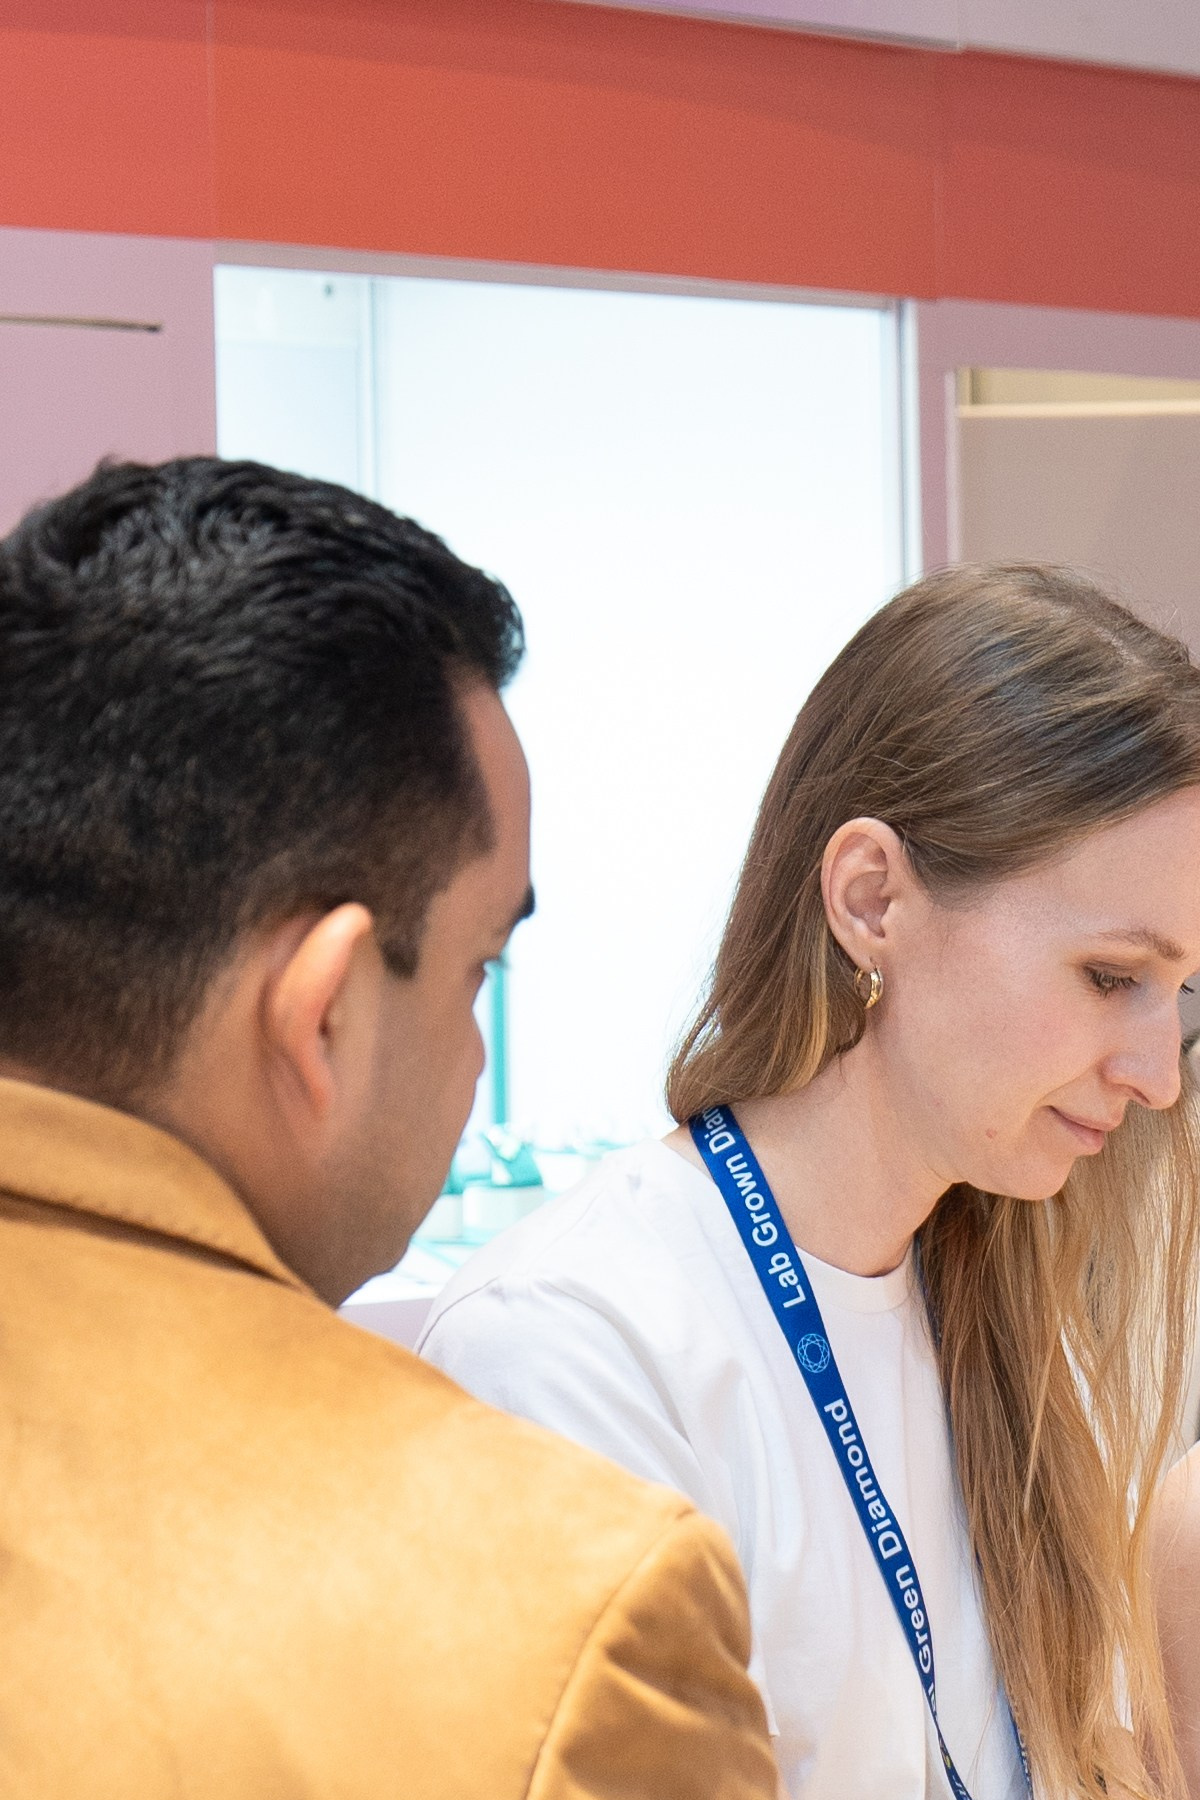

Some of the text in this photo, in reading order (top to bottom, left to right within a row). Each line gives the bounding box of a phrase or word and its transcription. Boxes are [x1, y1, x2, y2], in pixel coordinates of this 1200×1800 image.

[726, 1152, 779, 1247] Grown
[768, 1252, 806, 1308] Lab
[823, 1398, 932, 1675] Green Diamond
